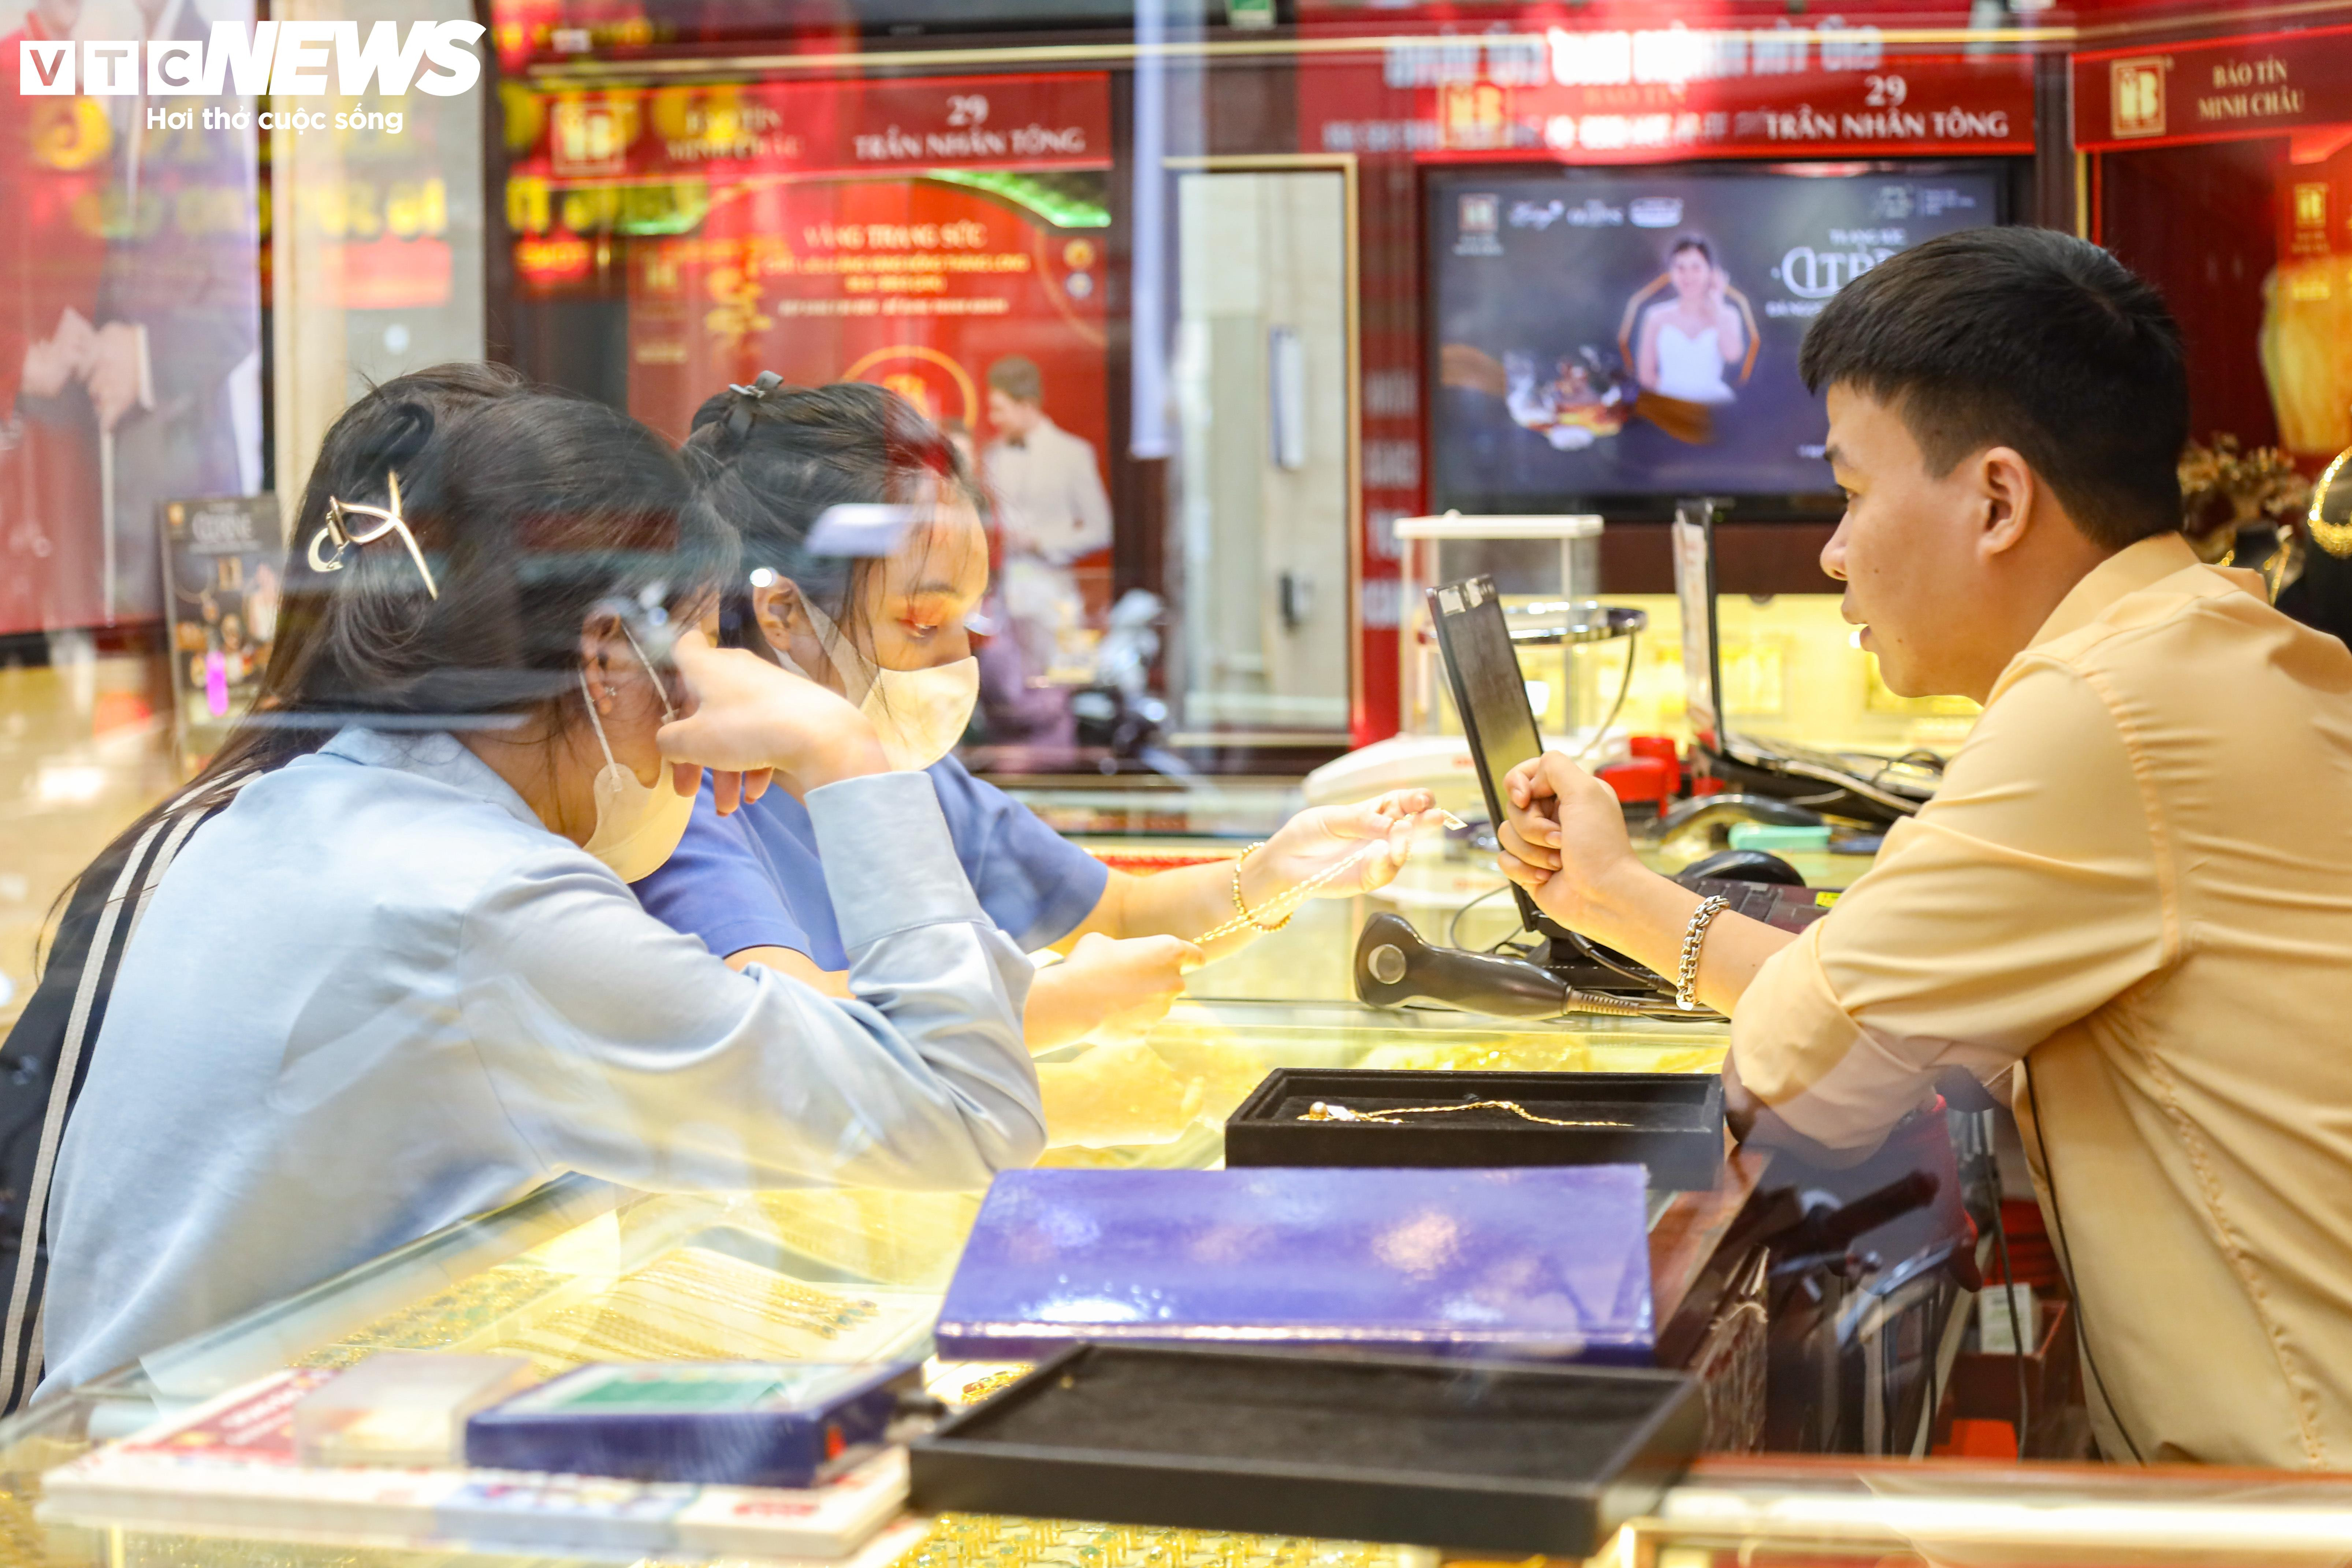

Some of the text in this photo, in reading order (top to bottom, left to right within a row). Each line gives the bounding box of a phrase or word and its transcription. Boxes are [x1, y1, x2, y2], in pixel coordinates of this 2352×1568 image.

[1864, 74, 1907, 107] 29
[2198, 85, 2305, 121] MINH CHÂU
[946, 94, 988, 126] 29
[1766, 104, 1836, 139] TRẦN
[1842, 107, 1925, 138] NHÂN
[1931, 106, 2009, 138] TÔNG
[926, 125, 1006, 157] NHÂN
[1009, 123, 1086, 154] TÔNG
